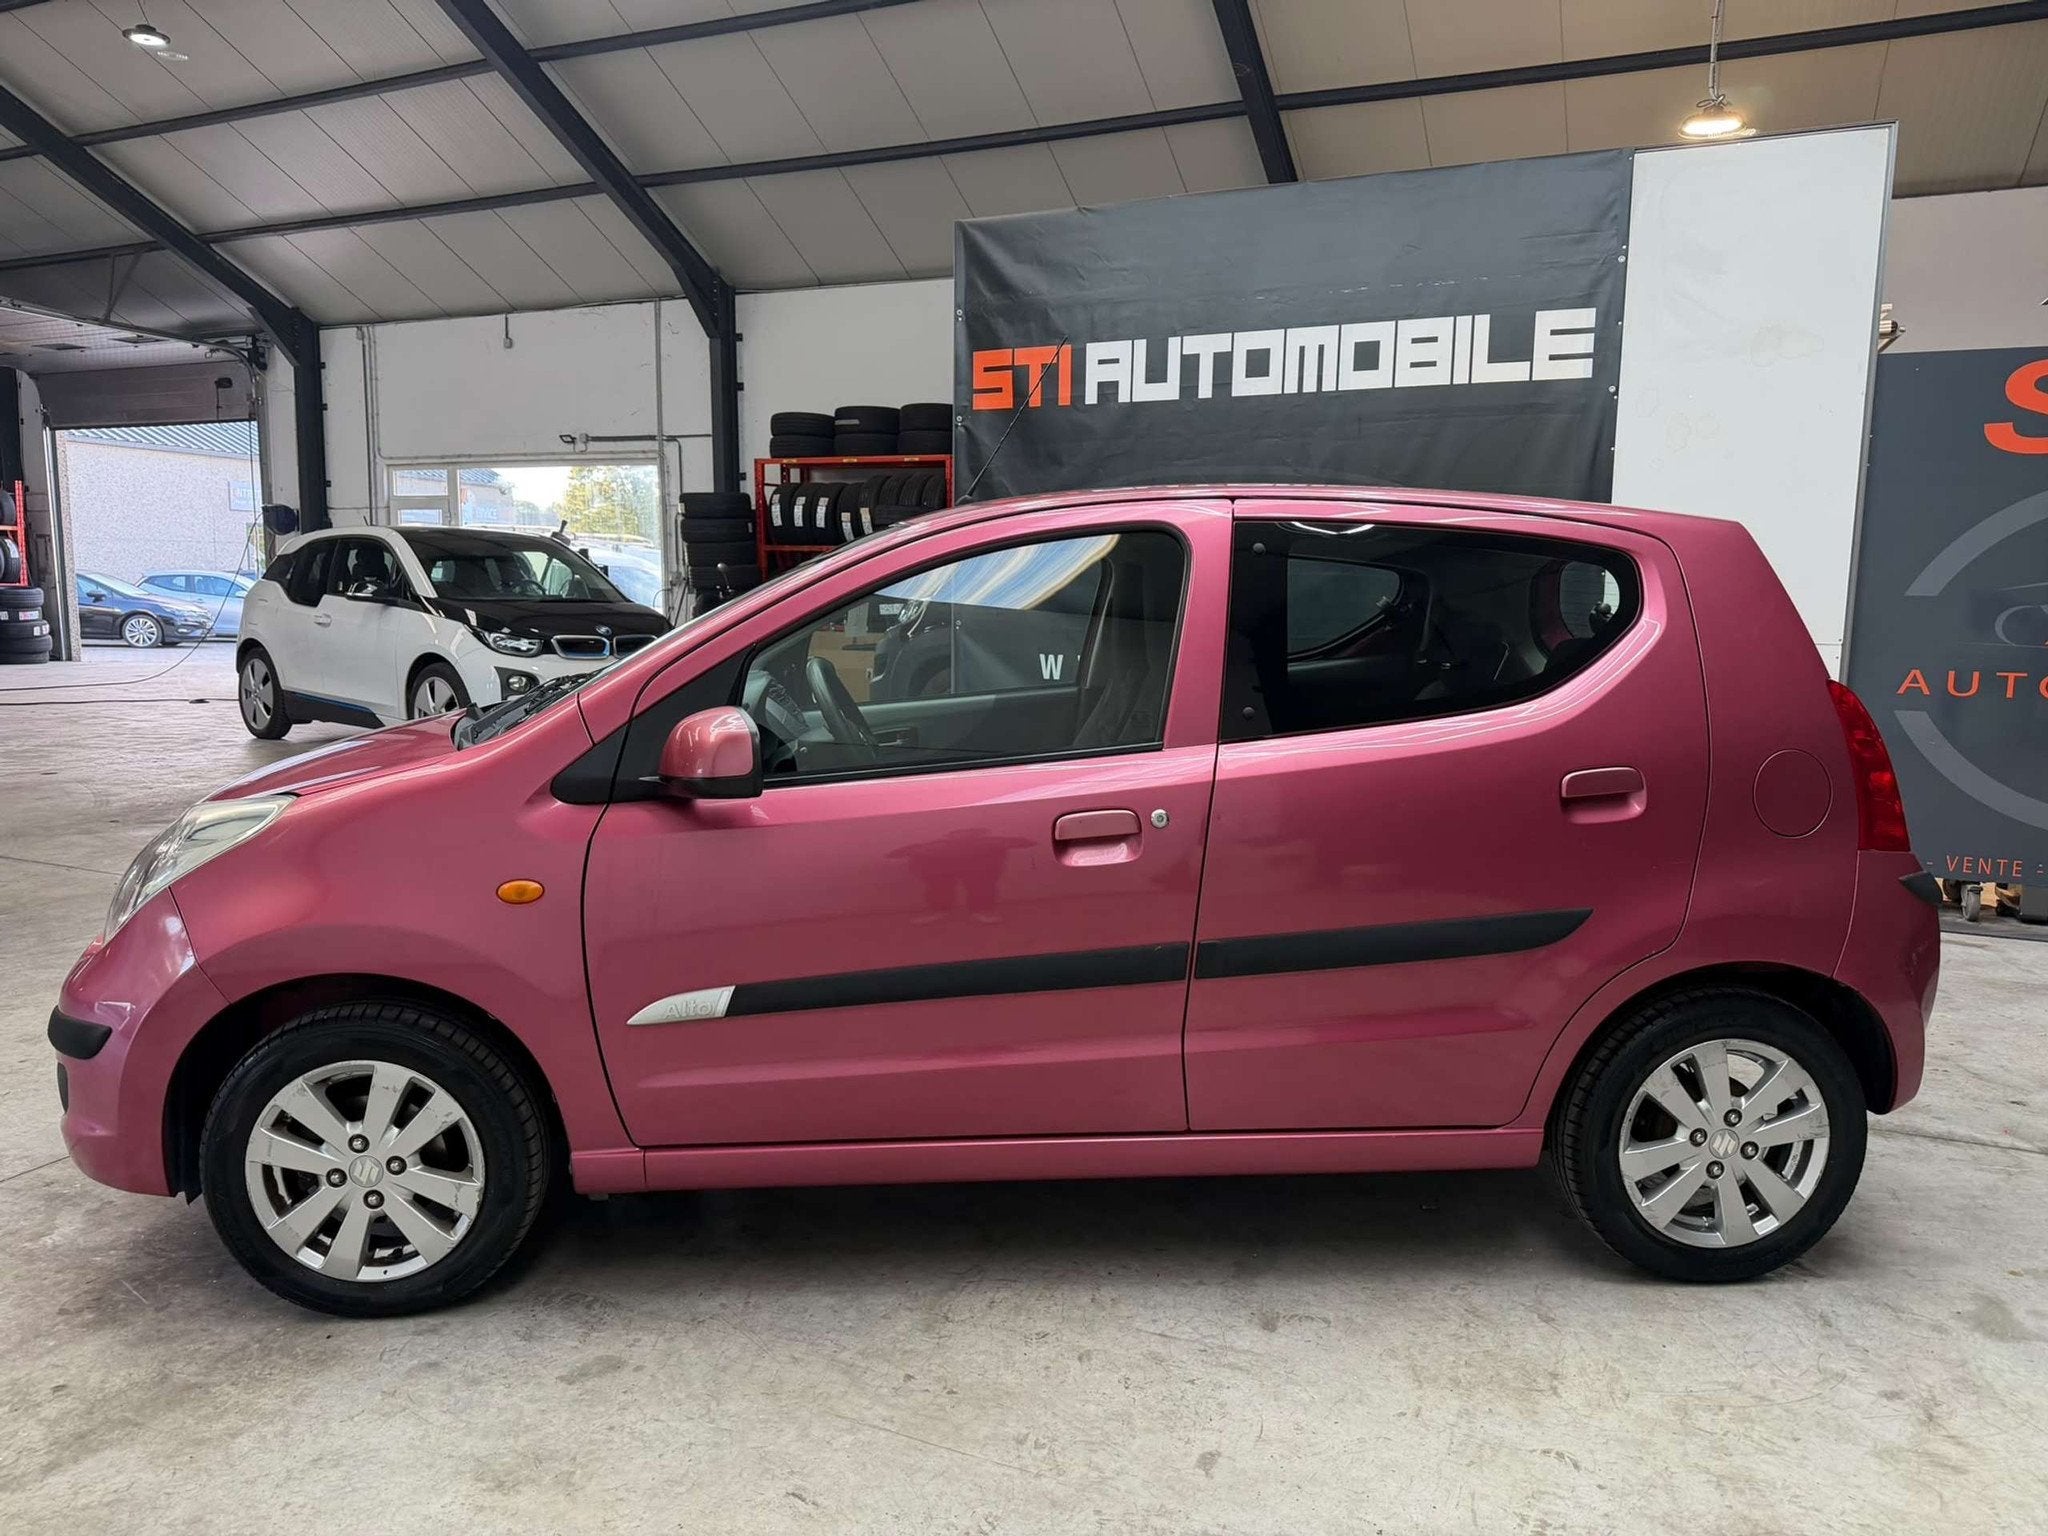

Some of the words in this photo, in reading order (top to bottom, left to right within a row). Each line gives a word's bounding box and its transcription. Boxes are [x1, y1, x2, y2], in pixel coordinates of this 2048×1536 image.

[972, 344, 1072, 411] STI
[1085, 307, 1596, 406] AUTOMOBILE
[1896, 668, 2048, 700] AUT
[1946, 855, 2023, 877] VENTE
[664, 999, 713, 1019] Alto
